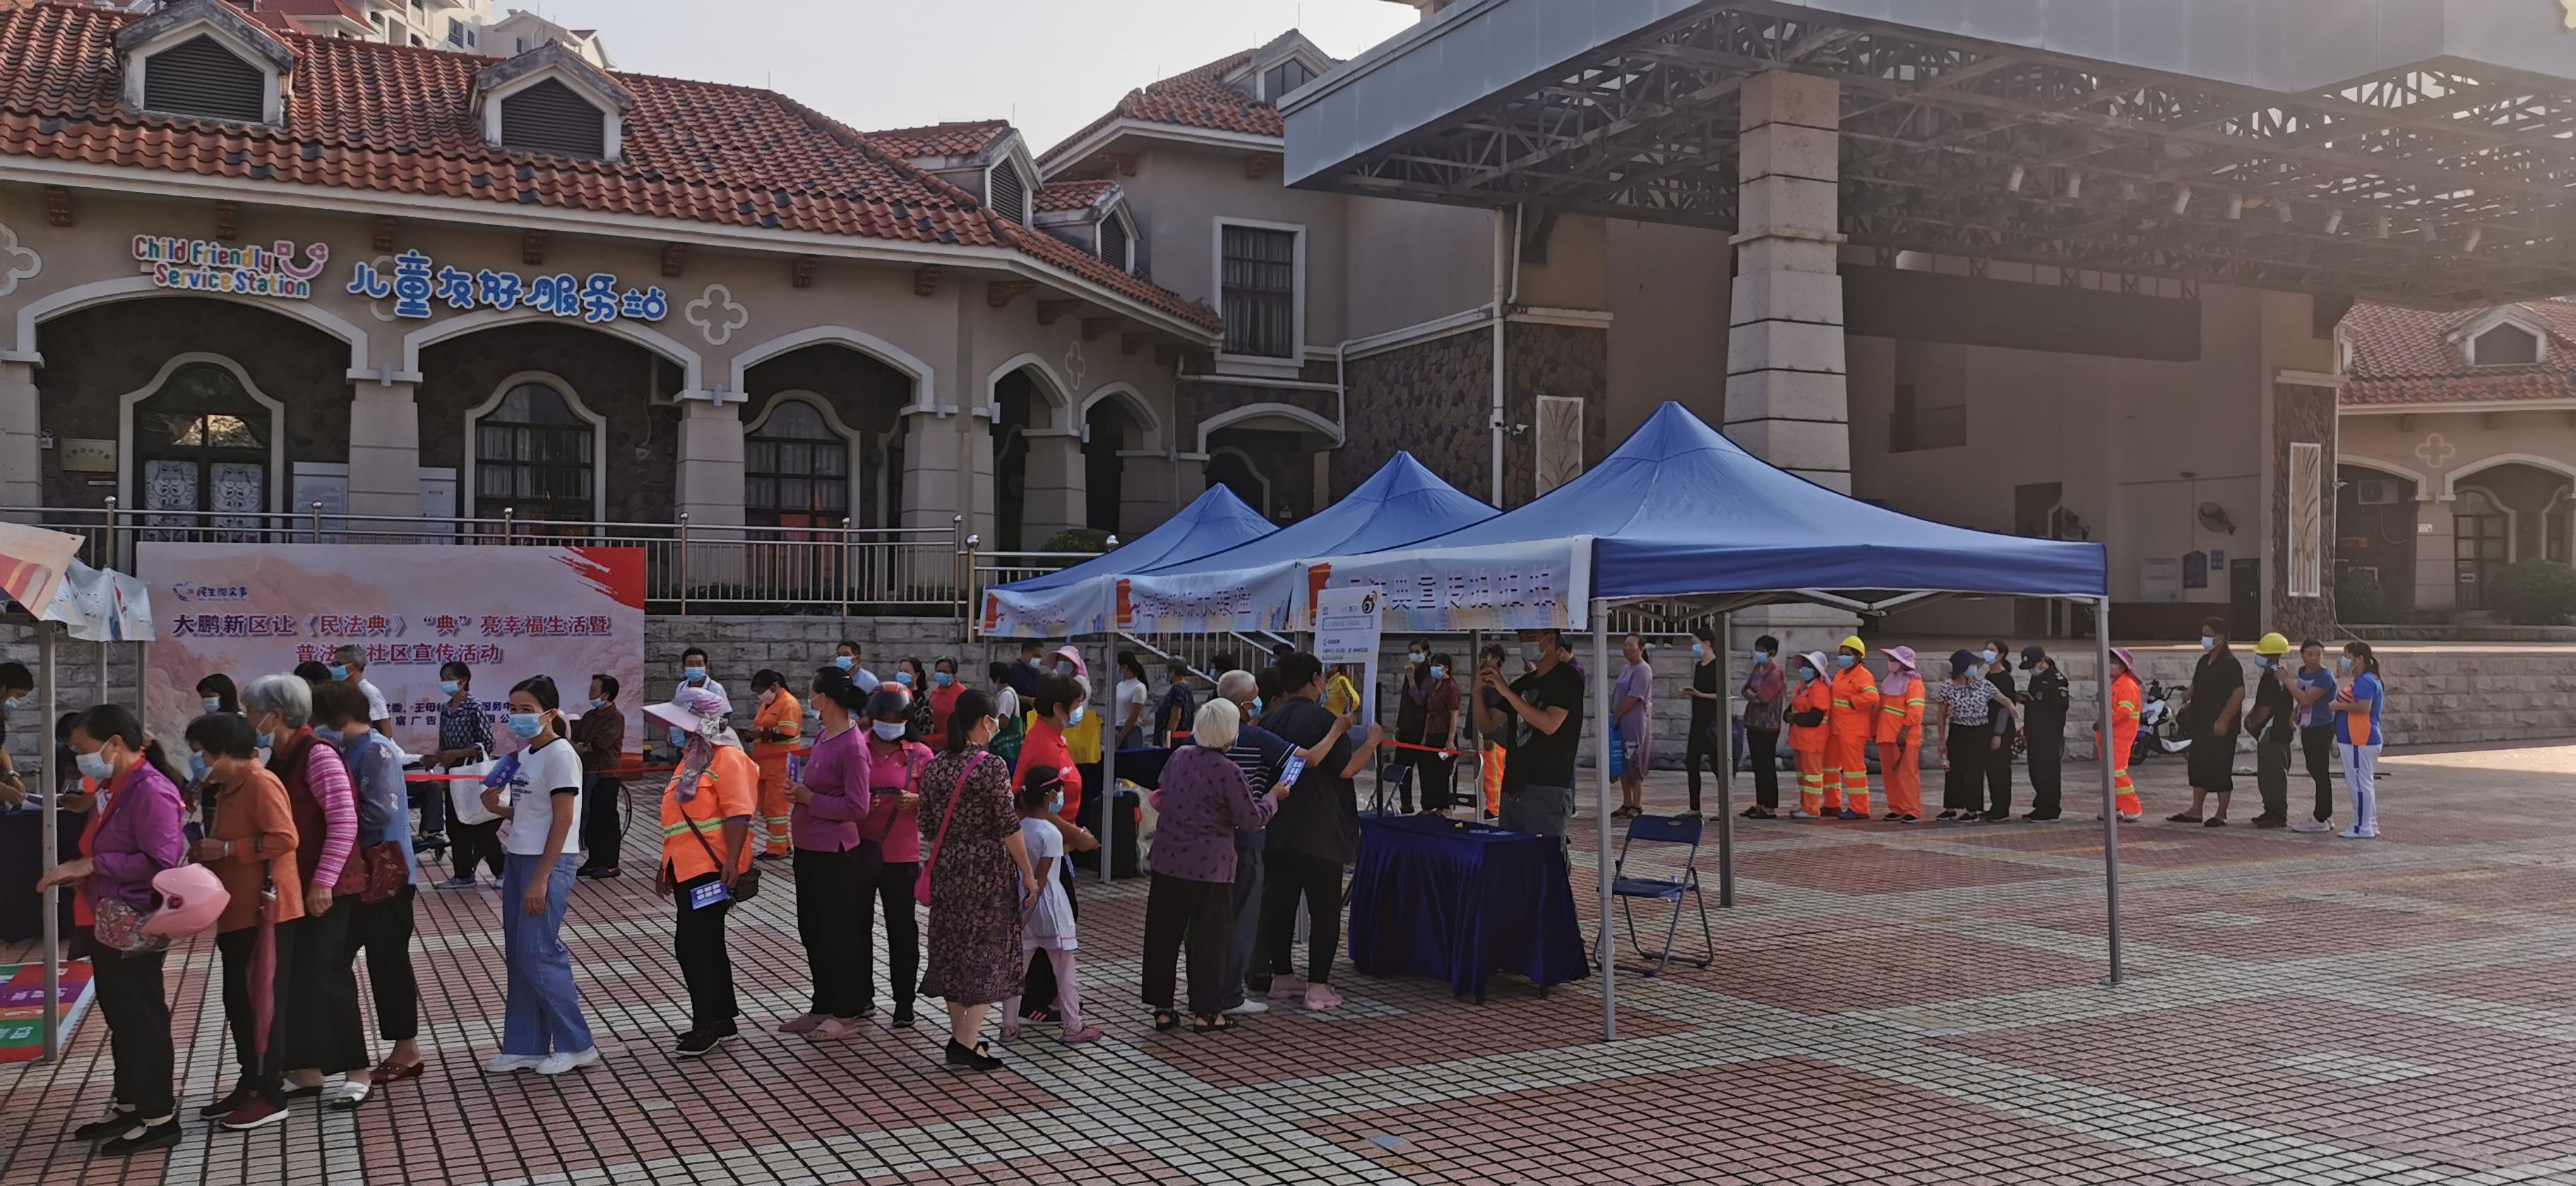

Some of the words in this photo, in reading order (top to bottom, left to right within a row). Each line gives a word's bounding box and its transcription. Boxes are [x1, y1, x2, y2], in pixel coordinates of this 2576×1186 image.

[134, 236, 186, 261] Child
[192, 241, 273, 274] Friendly
[155, 263, 233, 290] Service
[234, 270, 308, 296] Station
[349, 250, 665, 322] 儿童友好服务站
[296, 642, 502, 662] 普法社区宣传活动
